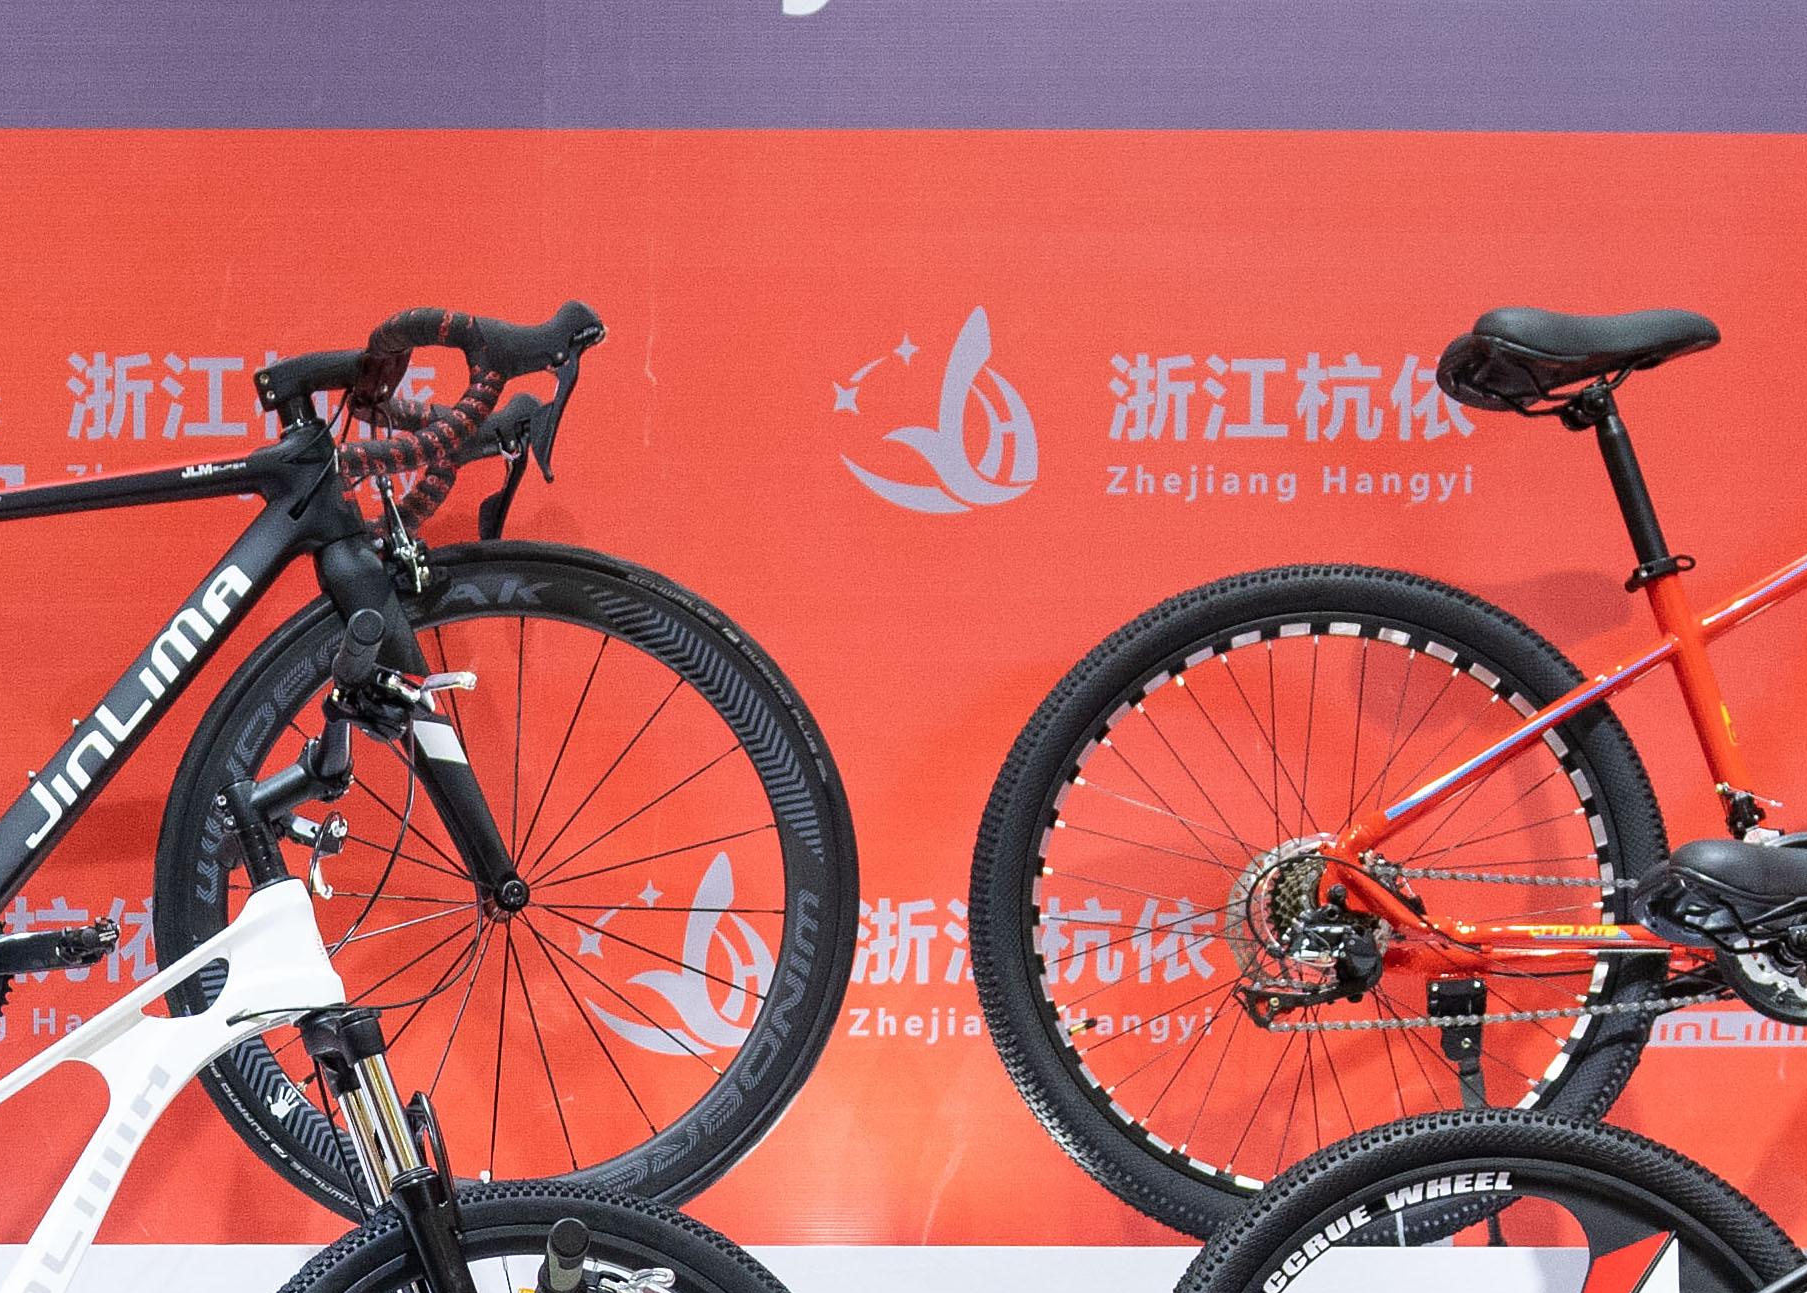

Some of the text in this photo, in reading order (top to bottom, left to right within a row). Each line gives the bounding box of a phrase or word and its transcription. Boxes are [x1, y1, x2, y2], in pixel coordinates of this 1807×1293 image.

[1106, 465, 1475, 502] Zhejiang Hangyi
[848, 1007, 1215, 1044] Zhejia Hangyi
[1384, 1171, 1514, 1215] WHEEL
